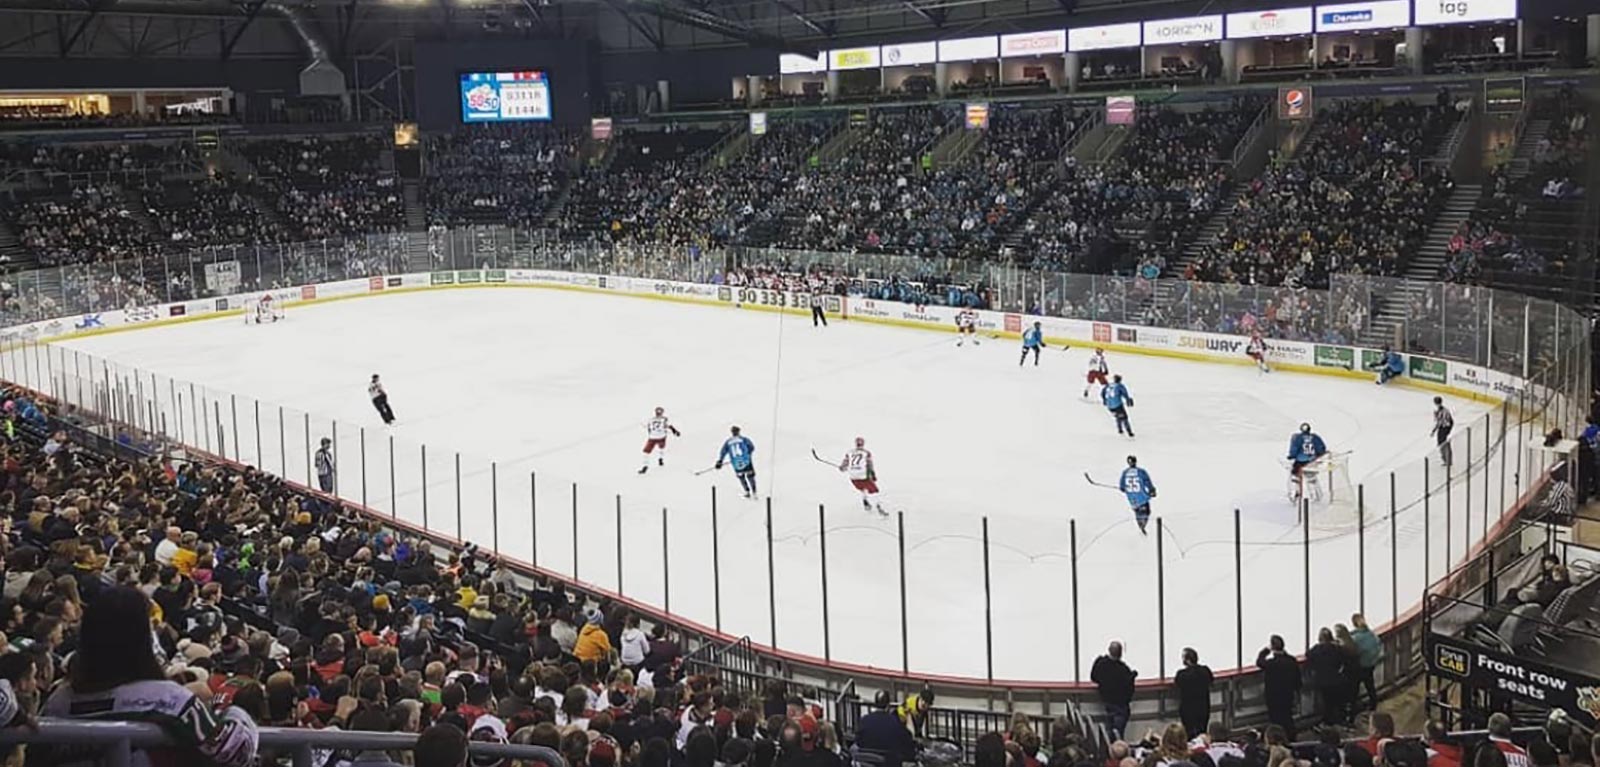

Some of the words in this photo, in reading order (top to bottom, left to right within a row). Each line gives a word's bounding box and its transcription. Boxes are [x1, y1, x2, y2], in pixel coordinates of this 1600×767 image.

[738, 289, 758, 304] 90
[761, 291, 787, 307] 333
[1177, 336, 1242, 352] SUBWAY
[1125, 476, 1141, 493] 55
[1477, 653, 1526, 679] Front
[1529, 671, 1567, 691] row
[1497, 677, 1546, 700] seats
